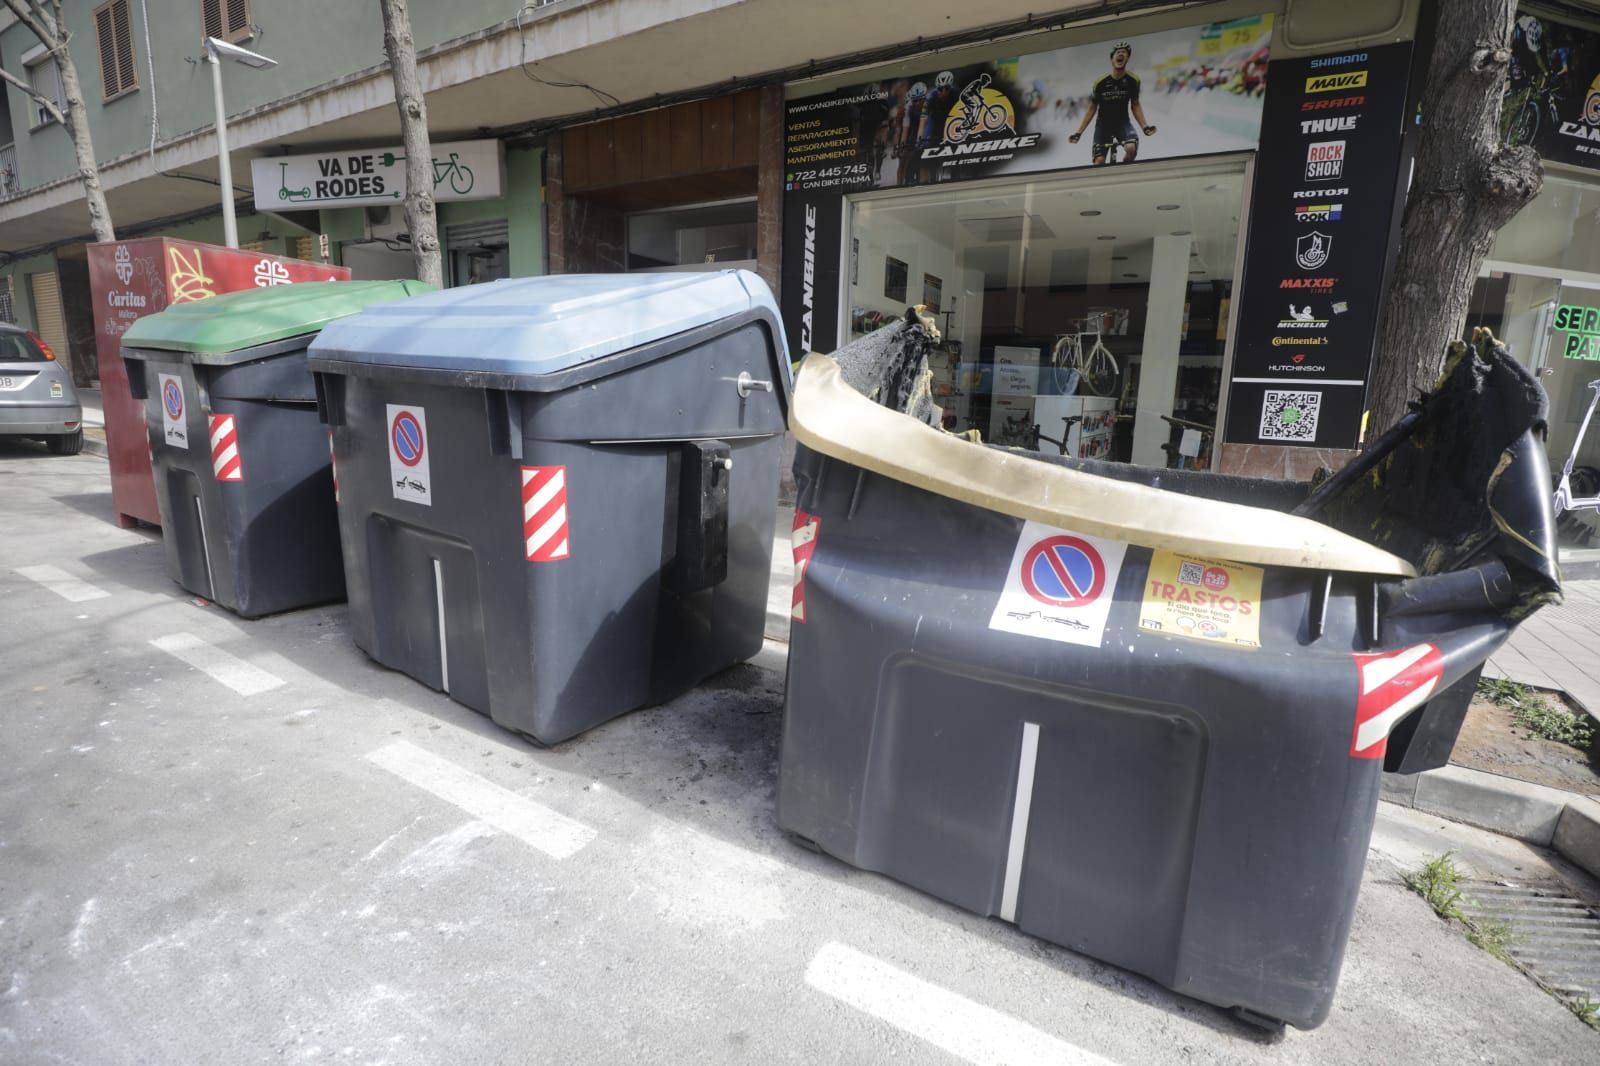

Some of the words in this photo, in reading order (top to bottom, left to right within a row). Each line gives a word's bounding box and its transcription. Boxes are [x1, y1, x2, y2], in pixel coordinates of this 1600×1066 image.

[1311, 53, 1368, 68] SHIMANO
[1309, 74, 1364, 90] MAVIC
[788, 91, 889, 114] WWW.CANBIKEPALMA.COM
[1301, 96, 1365, 111] SRAM
[788, 120, 821, 131] VENTAS
[1301, 115, 1357, 134] THULE
[787, 127, 850, 142] REPARACIONES
[788, 137, 858, 153] ASESORAMIENTO
[920, 134, 1041, 159] CANBIKE
[1310, 145, 1342, 161] ROCK
[787, 149, 856, 165] MANTENIMIENTO
[317, 158, 343, 177] VA
[348, 155, 375, 175] DE
[795, 170, 817, 181] 722
[818, 166, 841, 178] 445
[844, 164, 868, 175] 745
[1307, 161, 1341, 177] SHOX
[315, 175, 385, 198] RODES
[803, 181, 821, 189] CAN
[841, 175, 871, 184] PALMA
[1293, 187, 1349, 199] ROTOR
[1280, 278, 1335, 288] MAXXIS
[1271, 336, 1321, 347] Continental
[1150, 581, 1253, 616] TRASTOS
